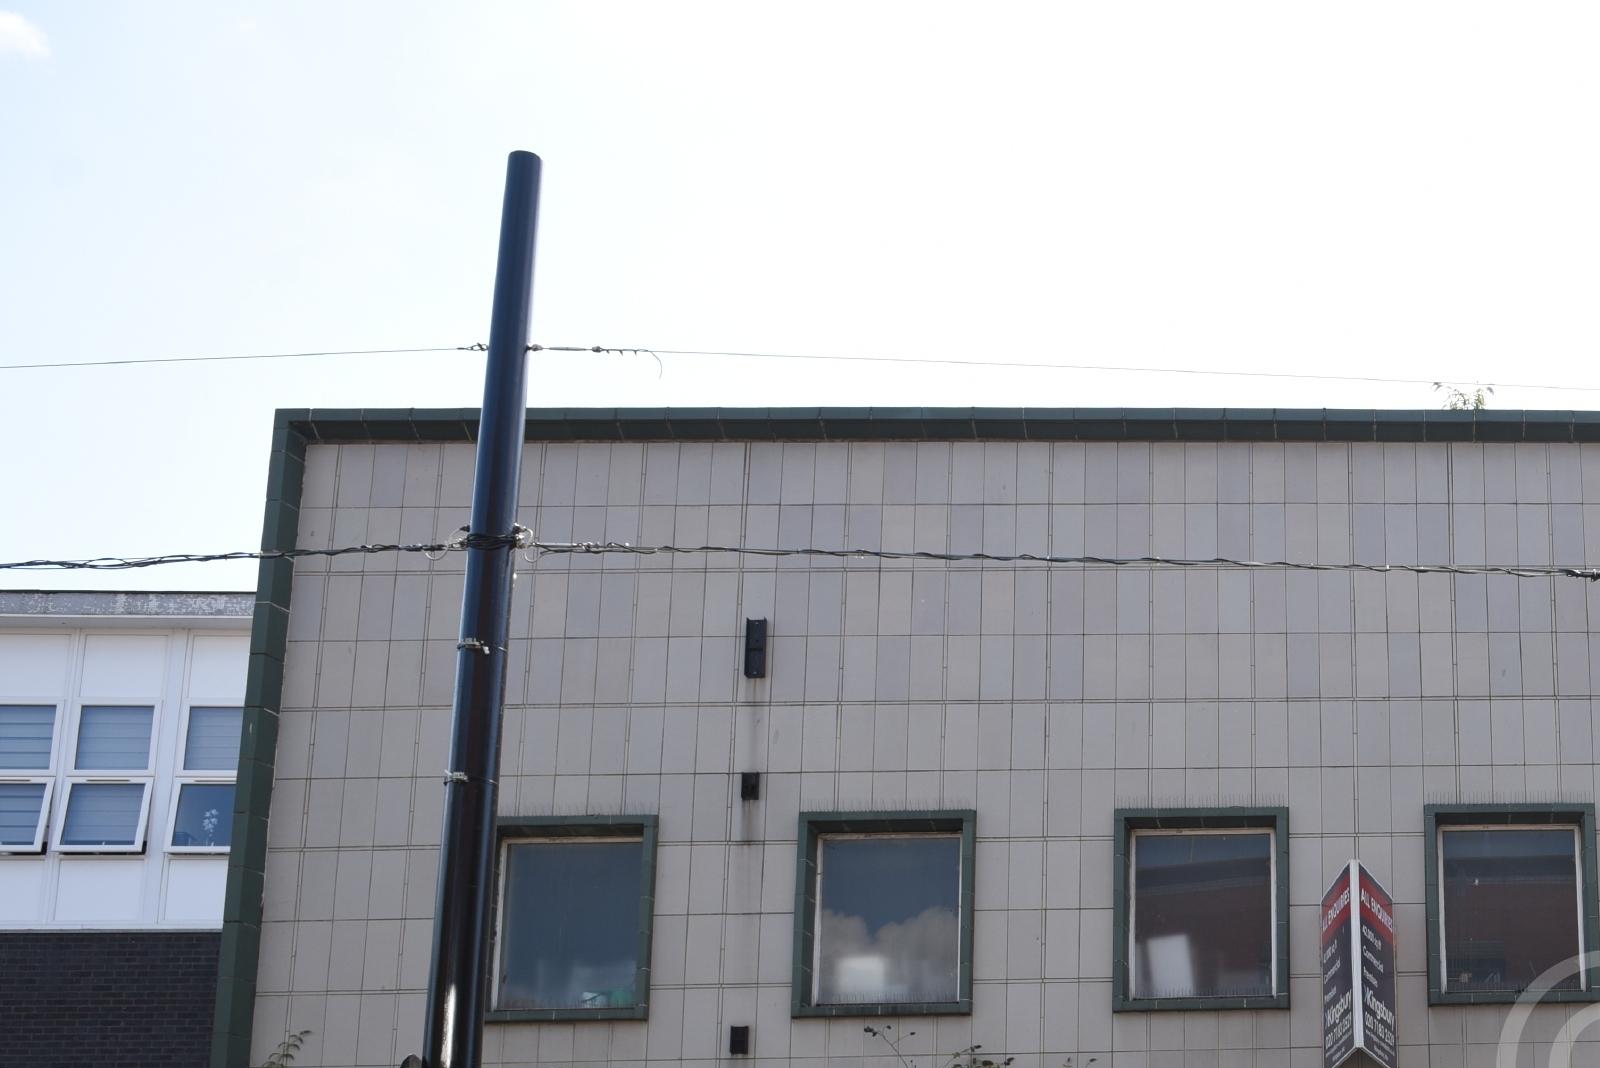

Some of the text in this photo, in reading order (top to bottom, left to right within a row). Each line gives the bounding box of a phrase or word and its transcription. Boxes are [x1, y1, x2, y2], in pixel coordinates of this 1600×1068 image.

[1361, 887, 1370, 909] ALL
[1327, 989, 1352, 1027] Kingsbury
[1366, 986, 1395, 1032] Kingsbury
